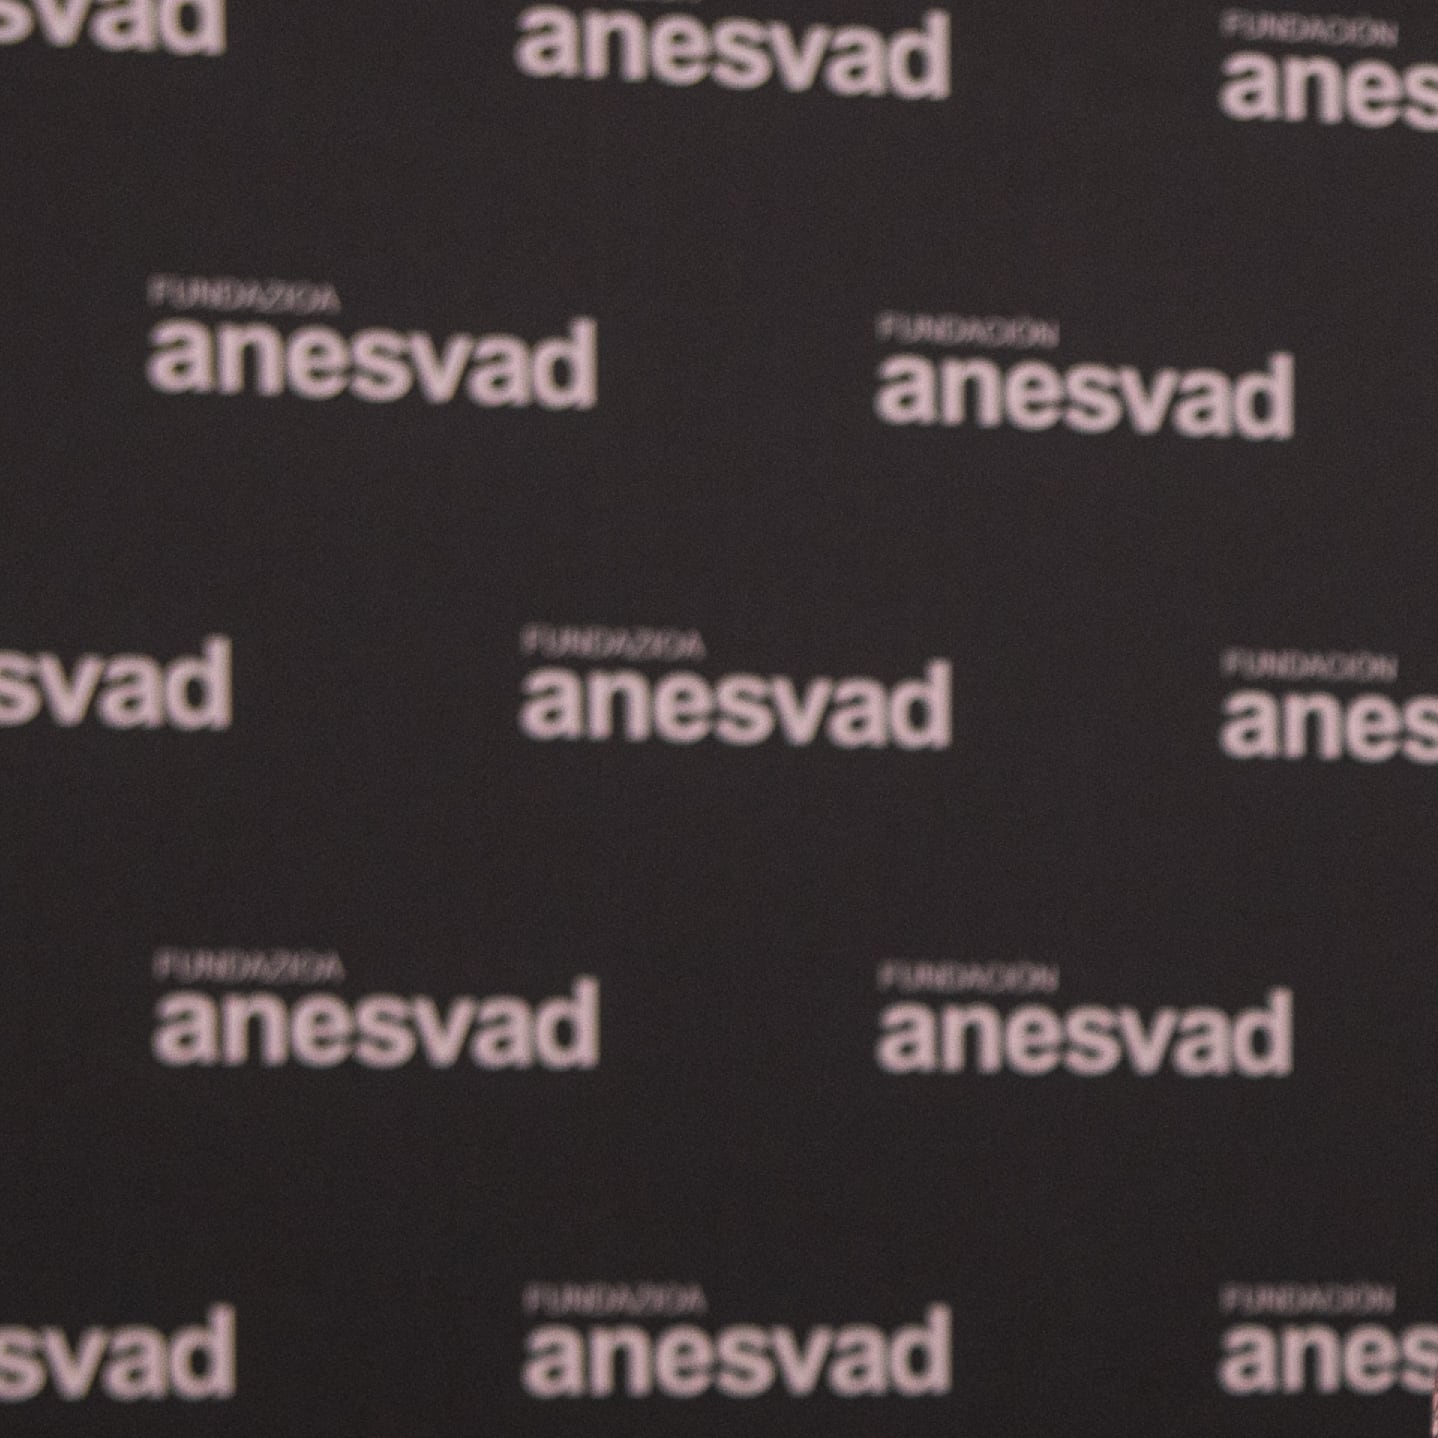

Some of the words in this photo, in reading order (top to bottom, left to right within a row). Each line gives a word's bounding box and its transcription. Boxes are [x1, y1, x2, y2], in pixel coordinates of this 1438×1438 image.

[516, 6, 950, 99] anesvad
[148, 317, 597, 410] anesvad
[876, 351, 1294, 441] anesvad
[0, 634, 232, 731] svad
[521, 659, 951, 750] anesvad
[154, 977, 599, 1070] anesvad
[877, 987, 1292, 1077] anesvad
[0, 1303, 236, 1401] svad
[523, 1304, 951, 1398] anesvad
